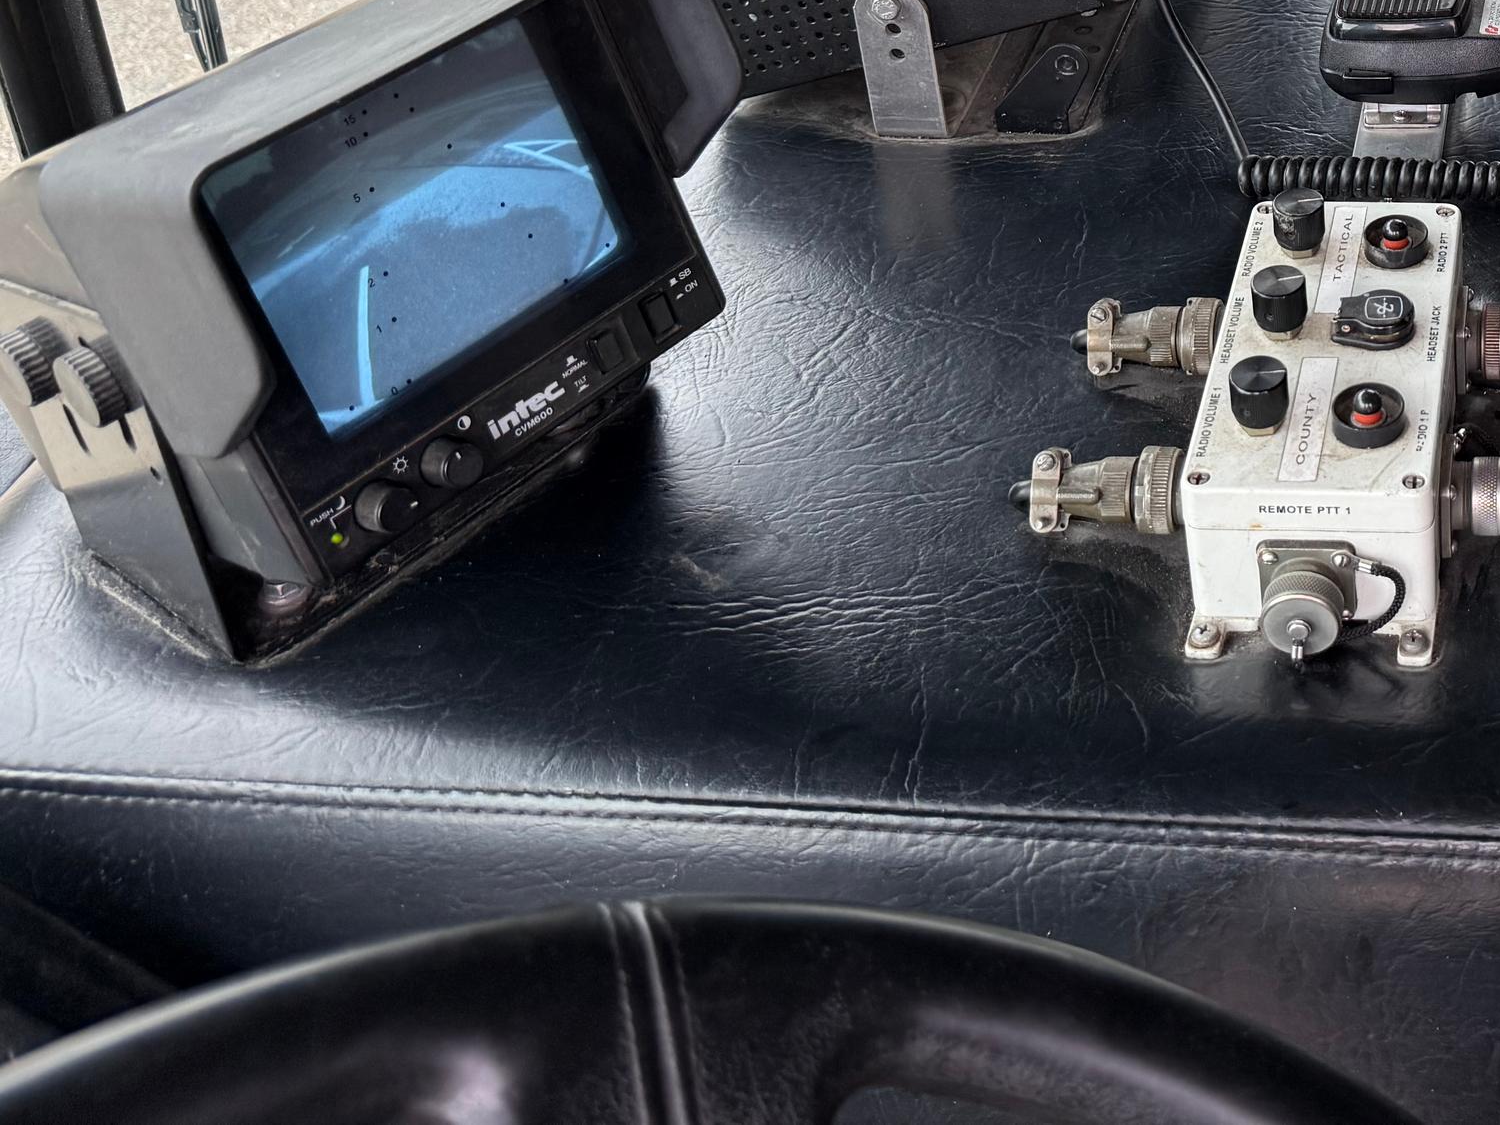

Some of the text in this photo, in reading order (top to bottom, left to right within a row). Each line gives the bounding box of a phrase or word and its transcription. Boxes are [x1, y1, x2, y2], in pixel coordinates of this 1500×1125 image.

[343, 114, 357, 126] 15
[344, 136, 358, 149] 10
[352, 193, 361, 204] 5
[1247, 225, 1263, 256] VOLUME
[1332, 213, 1354, 283] TACTICAL
[1241, 254, 1255, 277] RADIO
[1436, 250, 1448, 273] RADIO
[367, 277, 376, 288] 2
[678, 267, 692, 280] SB
[684, 279, 699, 293] ON
[375, 324, 383, 334] 1
[1219, 296, 1245, 364] HEADSET VOLUME
[1426, 305, 1442, 362] HEADSET JACK
[562, 359, 589, 379] NORMAL
[573, 375, 588, 388] TILT
[486, 380, 566, 440] intec
[514, 406, 554, 437] CVM600
[1195, 428, 1212, 458] RADIO
[1204, 392, 1222, 428] VOLUME
[1295, 392, 1318, 465] COUNTY
[309, 507, 335, 527] PUSH
[1258, 504, 1352, 515] REMOTE PTT 1
